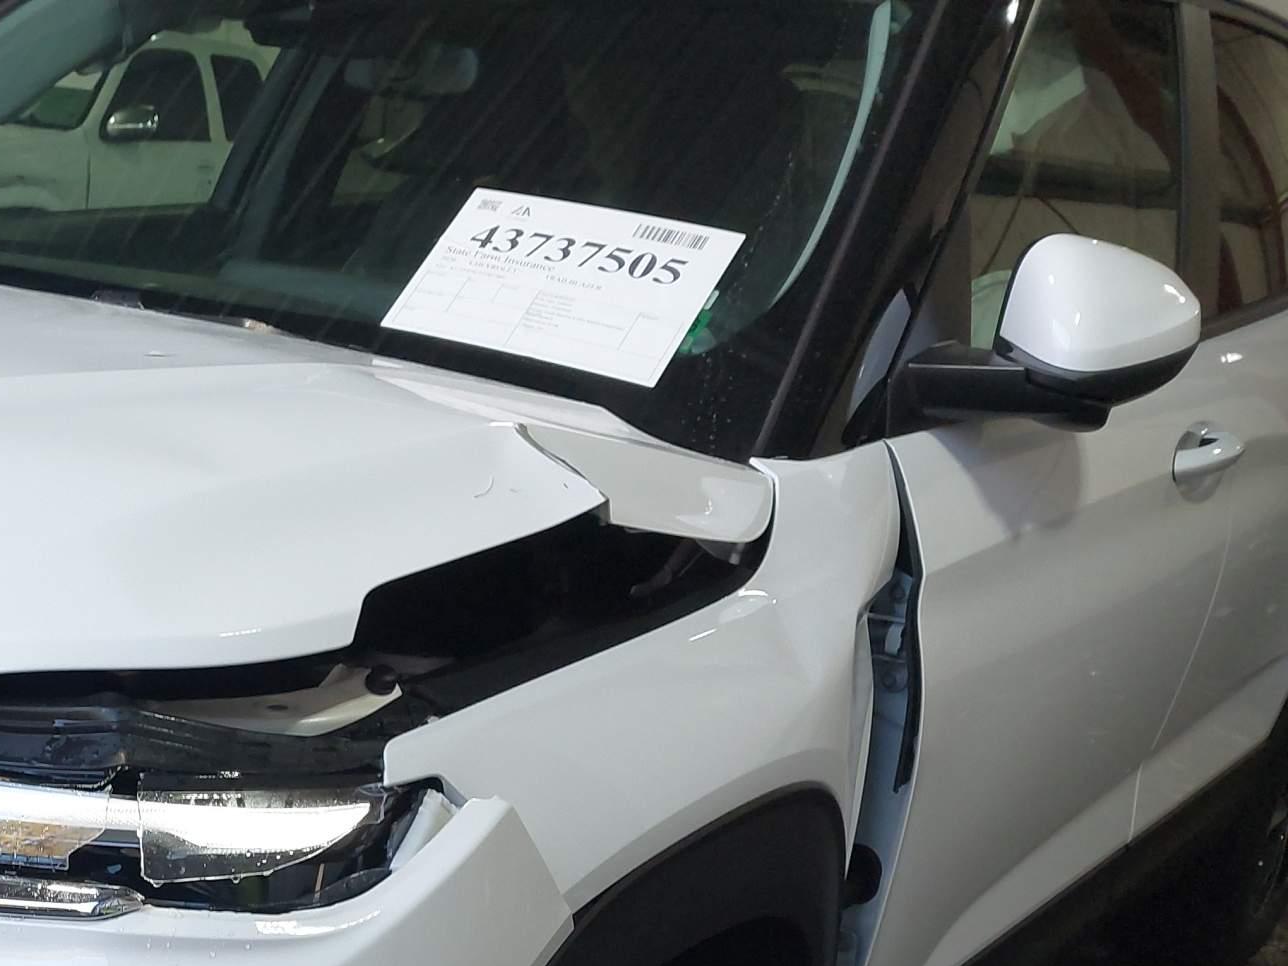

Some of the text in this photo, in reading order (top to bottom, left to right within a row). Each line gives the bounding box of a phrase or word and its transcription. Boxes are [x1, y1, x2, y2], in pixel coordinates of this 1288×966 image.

[446, 245, 472, 258] State
[474, 250, 502, 263] Farm
[503, 255, 556, 273] Insurance
[469, 224, 689, 286] 43737505
